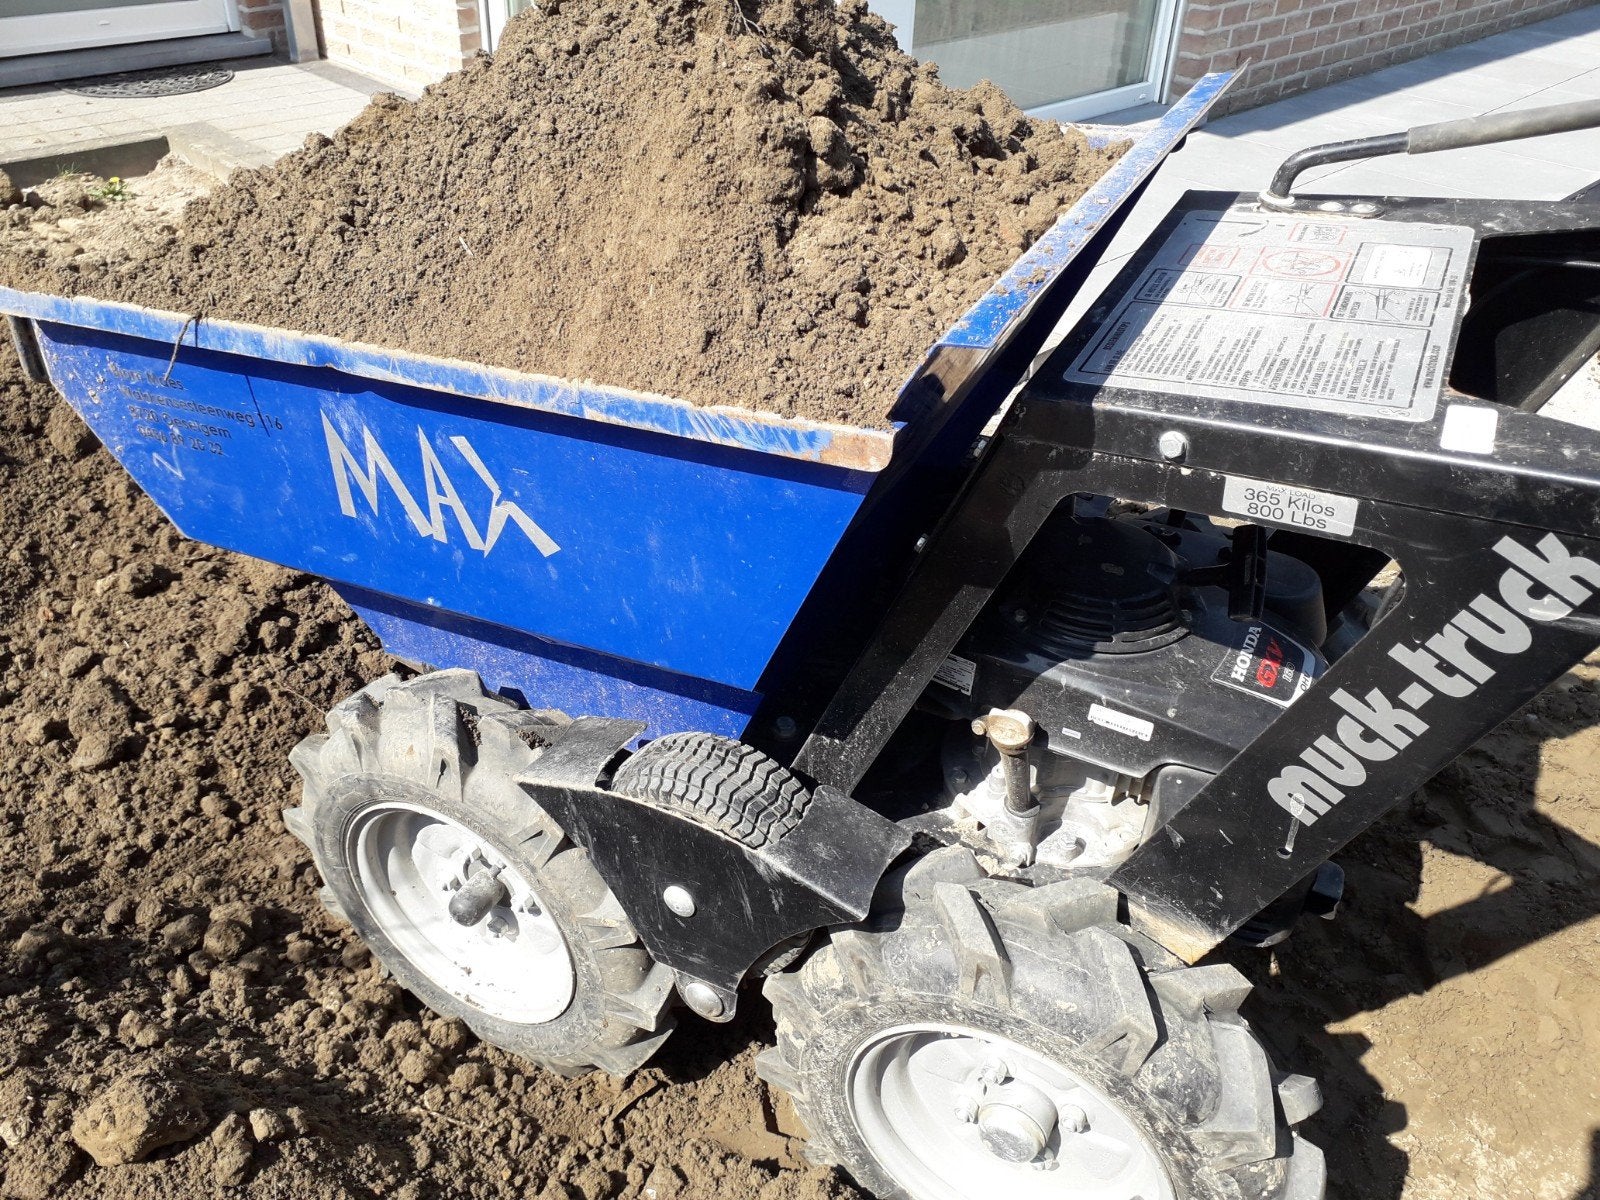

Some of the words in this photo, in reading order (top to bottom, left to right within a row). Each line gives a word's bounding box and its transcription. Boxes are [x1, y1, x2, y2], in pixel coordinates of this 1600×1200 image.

[320, 408, 561, 558] MAX
[1244, 488, 1281, 506] 365
[1287, 496, 1336, 517] Kilos
[1247, 503, 1284, 520] 800
[1291, 511, 1327, 529] Lbs
[1231, 626, 1262, 682] HONDA
[1267, 532, 1600, 827] muck-truck
